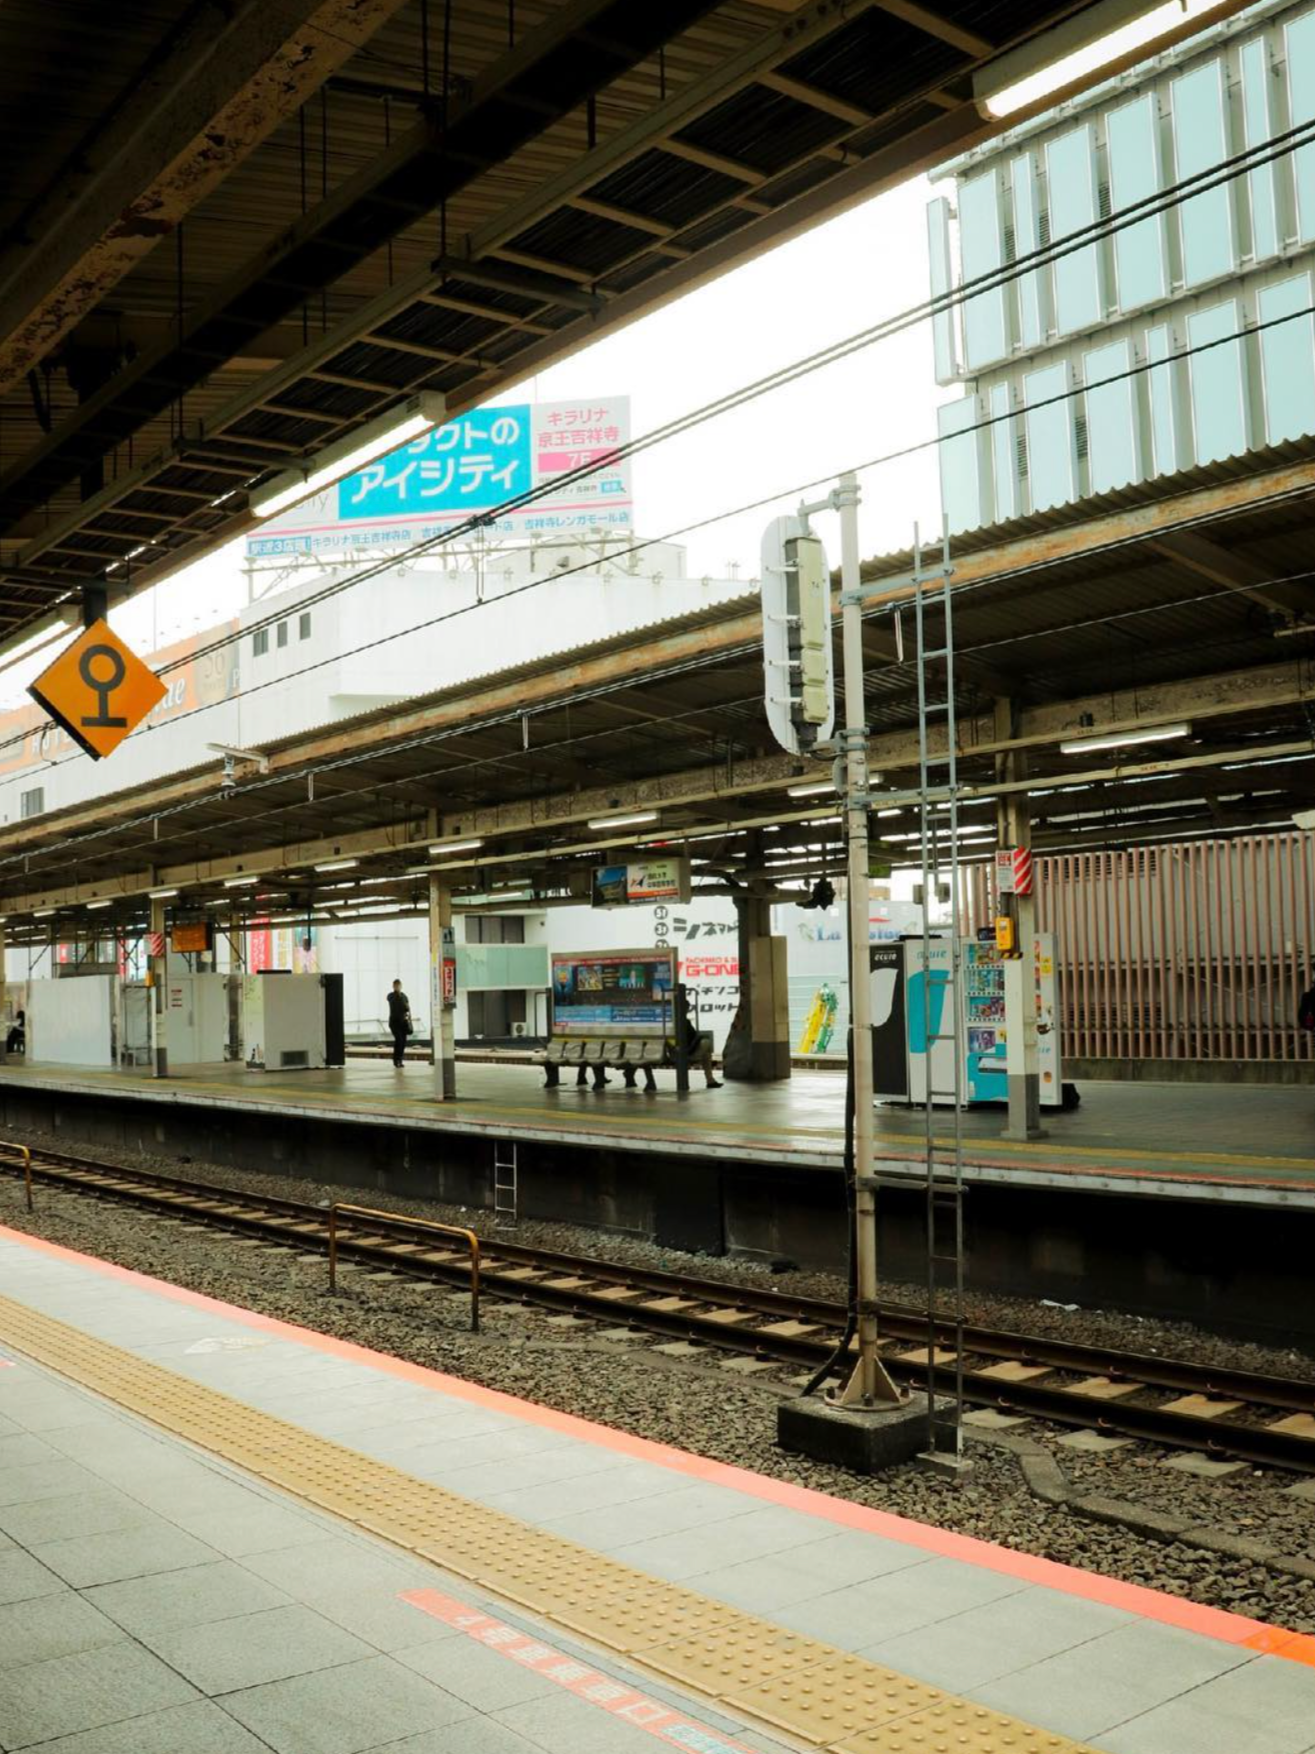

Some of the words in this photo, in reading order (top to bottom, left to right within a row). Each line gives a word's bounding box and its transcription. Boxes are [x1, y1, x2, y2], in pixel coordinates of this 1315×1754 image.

[547, 407, 609, 427] キラリナ
[537, 425, 620, 448] 京王吉祥寺
[351, 454, 520, 504] アイシティ
